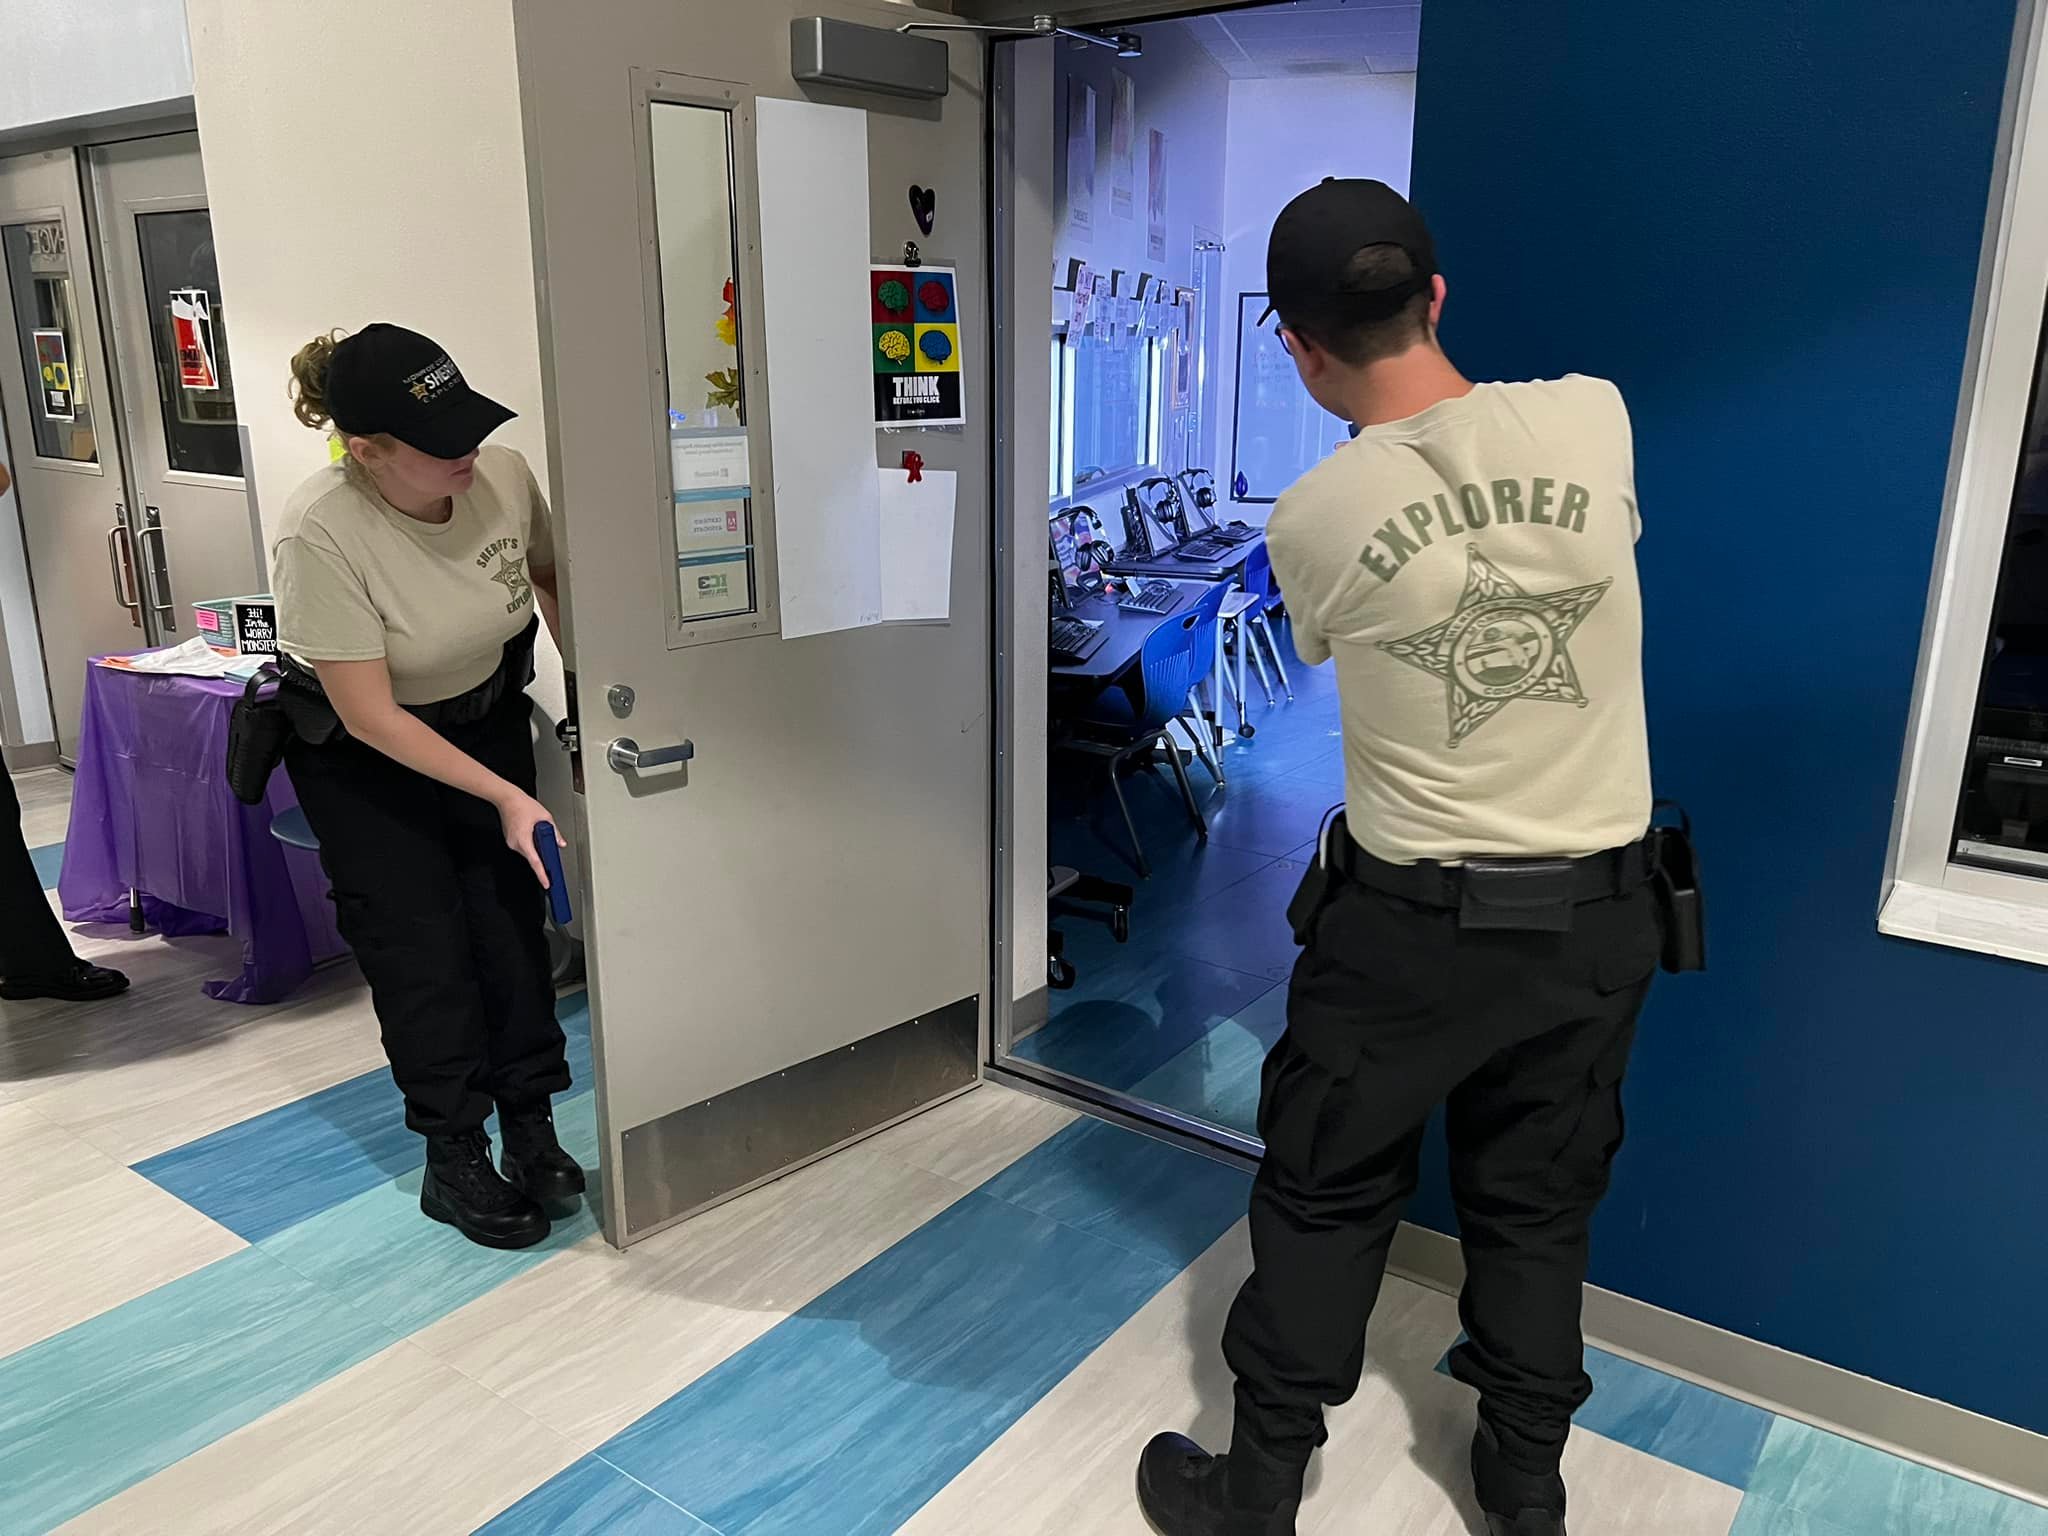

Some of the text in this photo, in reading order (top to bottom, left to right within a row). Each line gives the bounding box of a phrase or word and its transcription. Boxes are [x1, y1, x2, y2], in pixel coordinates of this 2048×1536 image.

[893, 376, 940, 397] THINK
[1358, 477, 1590, 583] EXPLORER
[245, 628, 273, 639] WORRY
